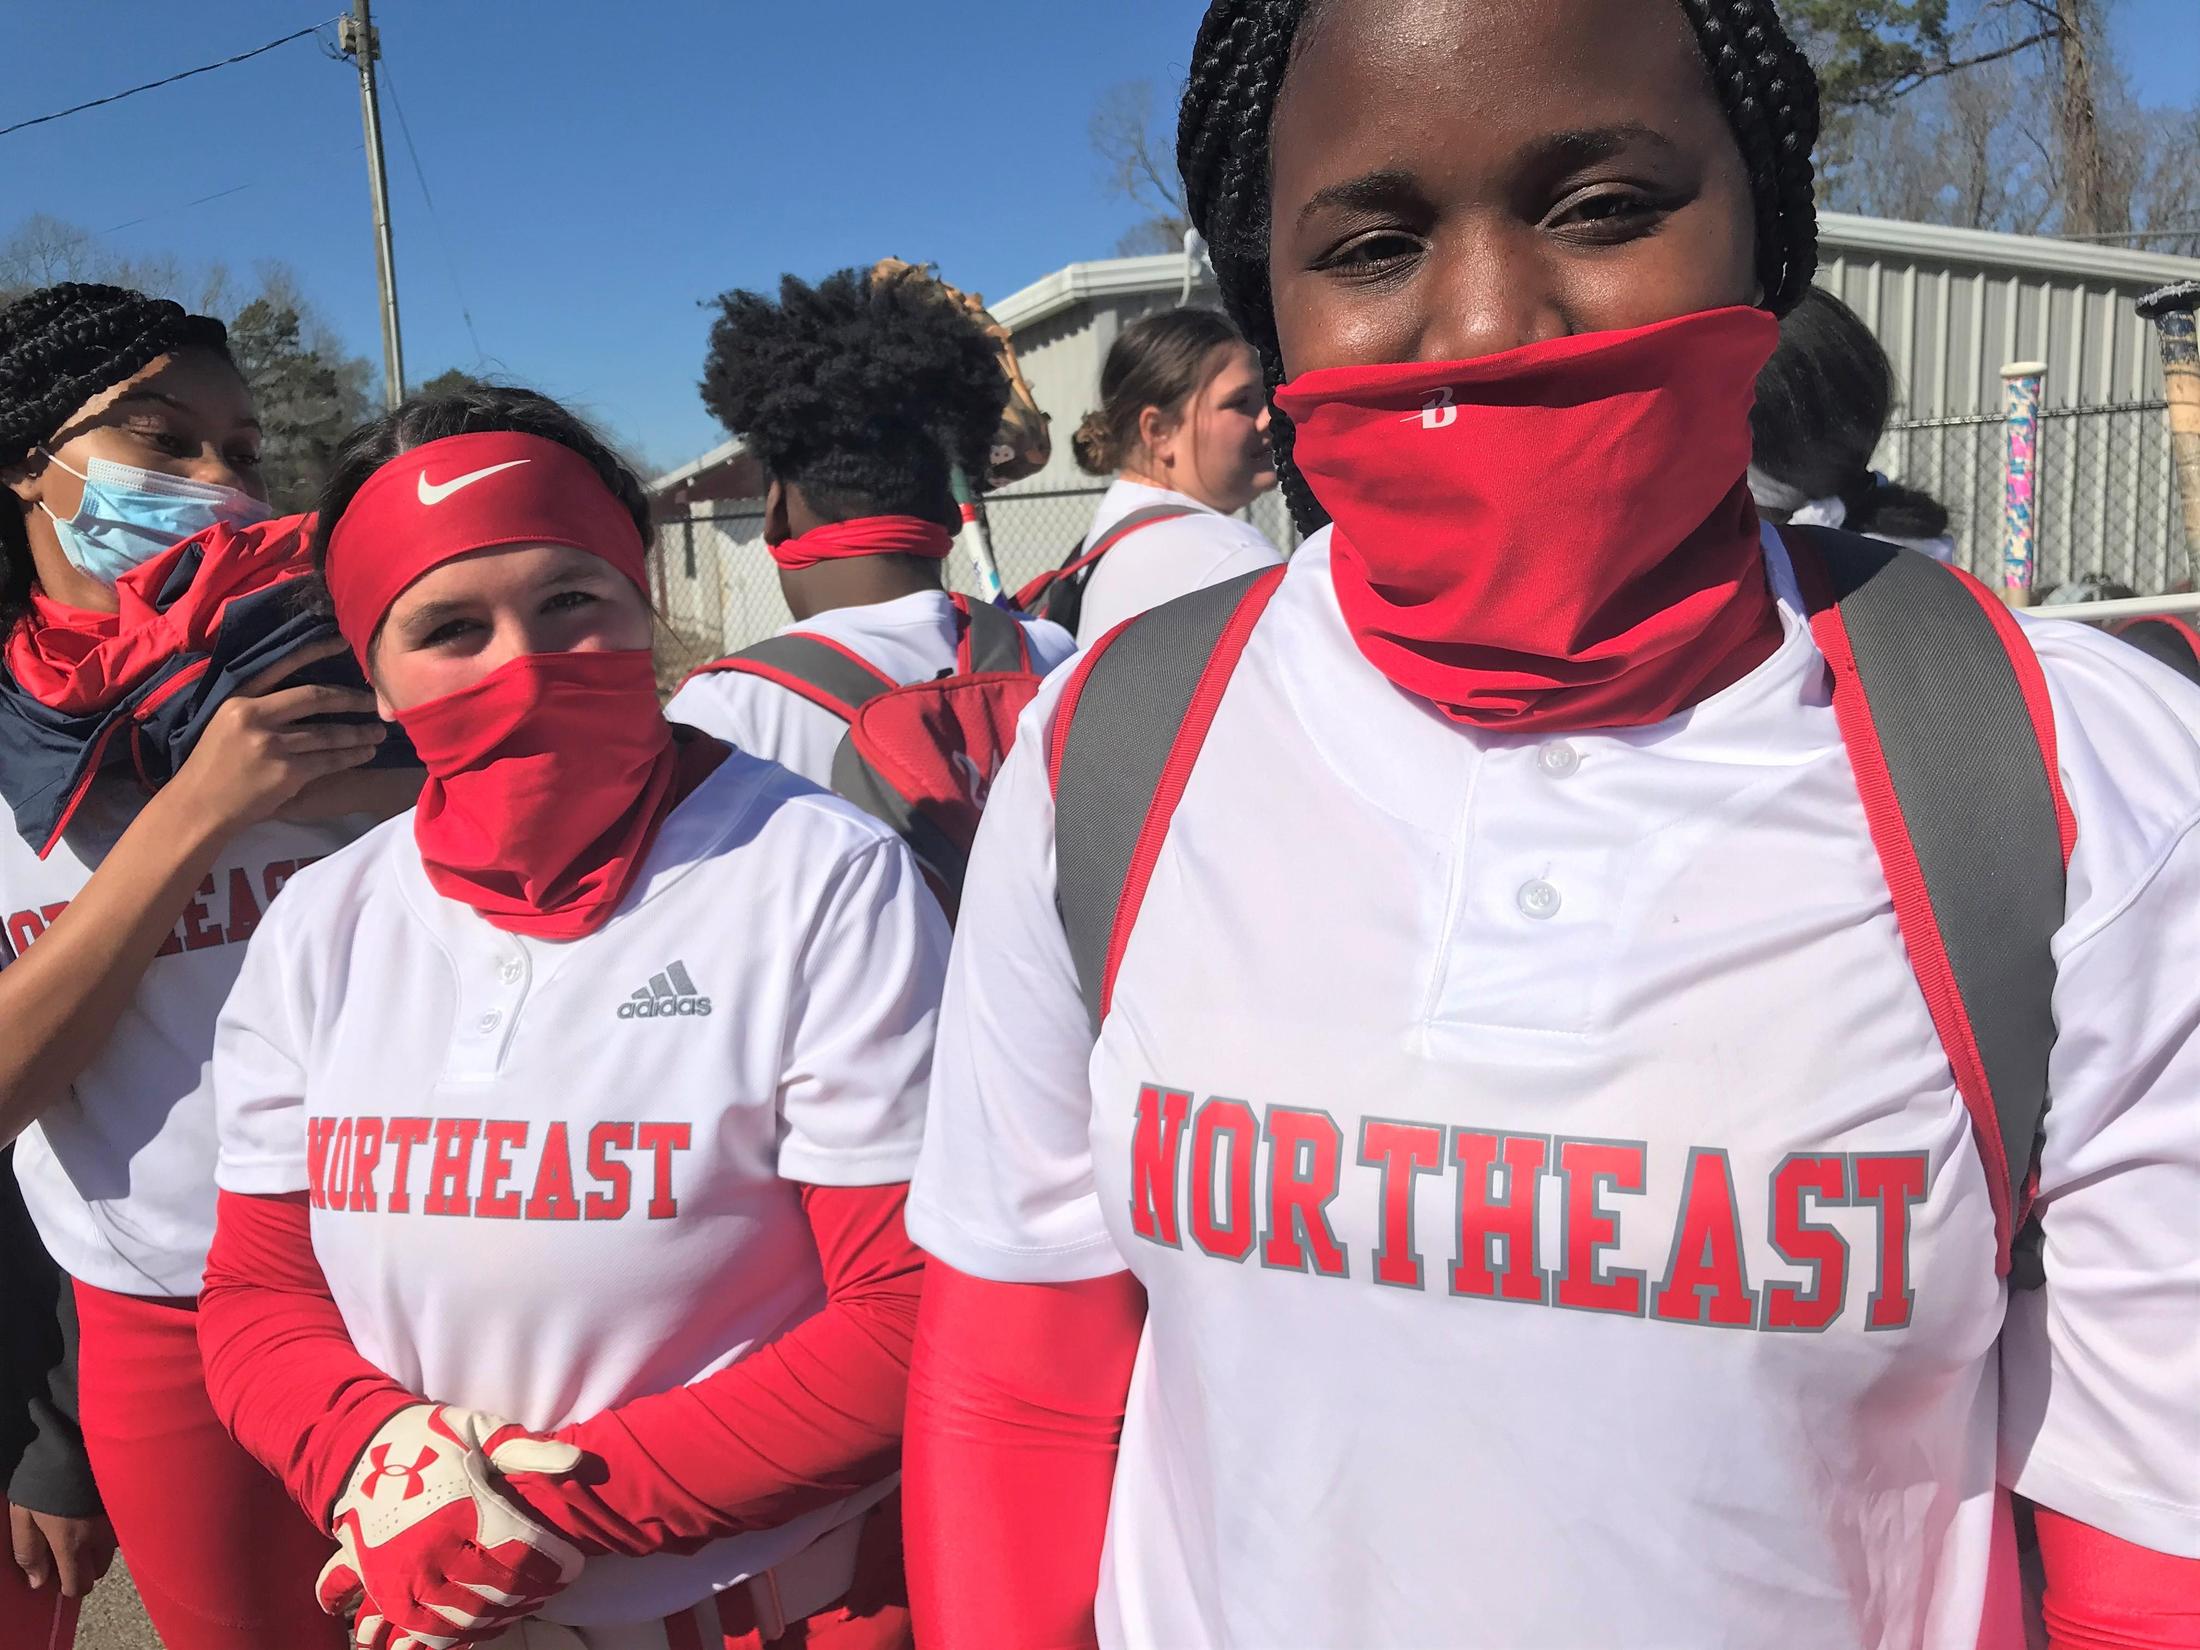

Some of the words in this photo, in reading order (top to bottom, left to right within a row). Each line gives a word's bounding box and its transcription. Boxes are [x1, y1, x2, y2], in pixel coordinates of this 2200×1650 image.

[617, 995, 712, 1019] adidas
[307, 1116, 692, 1220] NORTHEAST
[1129, 1082, 1929, 1333] NORTHEAST
